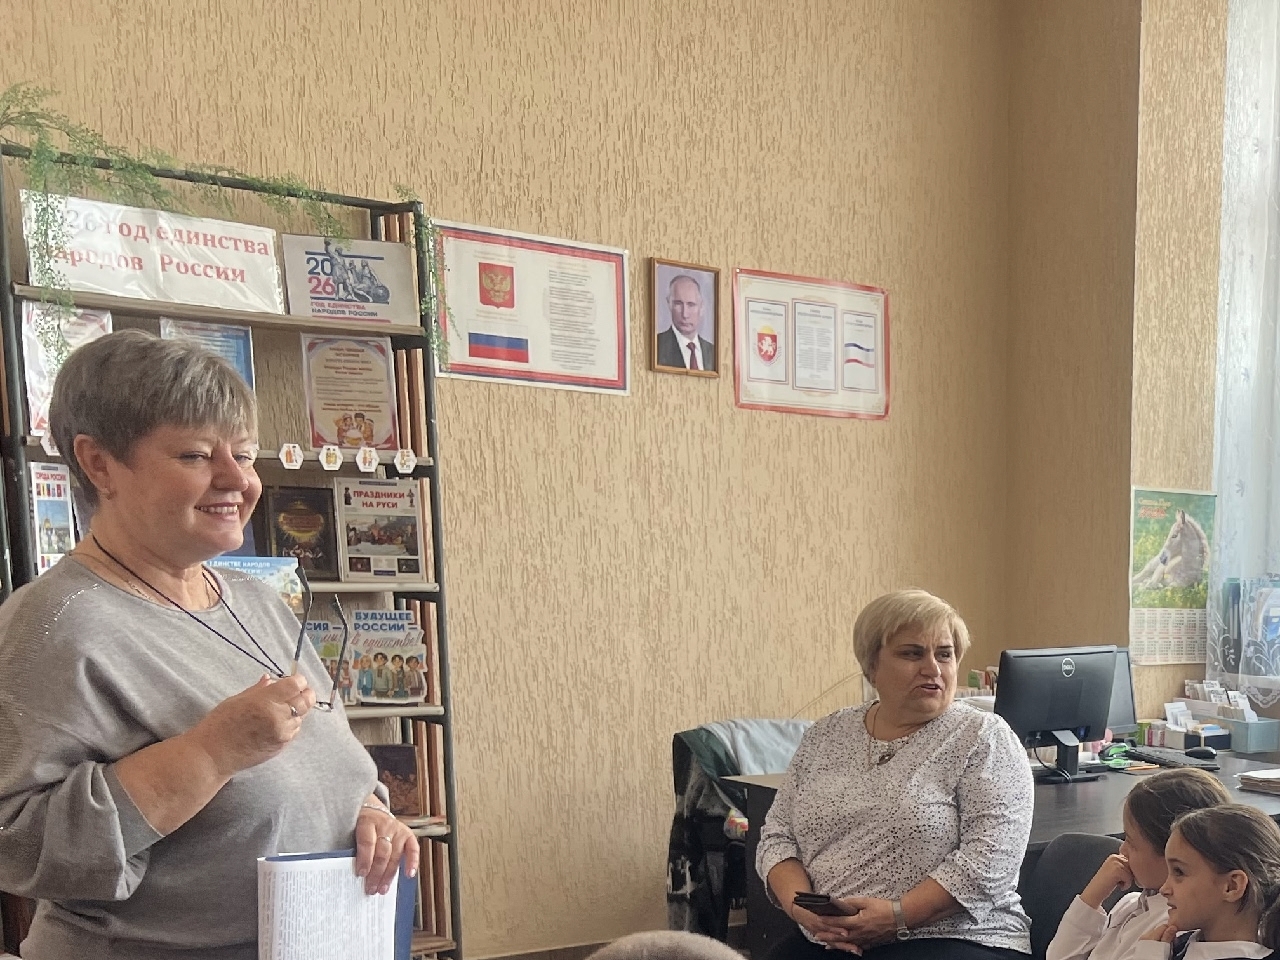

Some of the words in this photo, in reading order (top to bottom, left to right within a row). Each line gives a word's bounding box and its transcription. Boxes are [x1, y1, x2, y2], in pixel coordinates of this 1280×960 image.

[156, 225, 270, 256] единства
[50, 246, 143, 272] ародов
[158, 253, 247, 283] России
[306, 256, 333, 277] 20
[308, 275, 336, 296] 26
[353, 490, 405, 499] ПРАЗДНИКИ
[355, 611, 412, 621] БУДУЩЕЕ
[305, 622, 329, 631] СИЯ
[354, 622, 405, 631] РОССИИ
